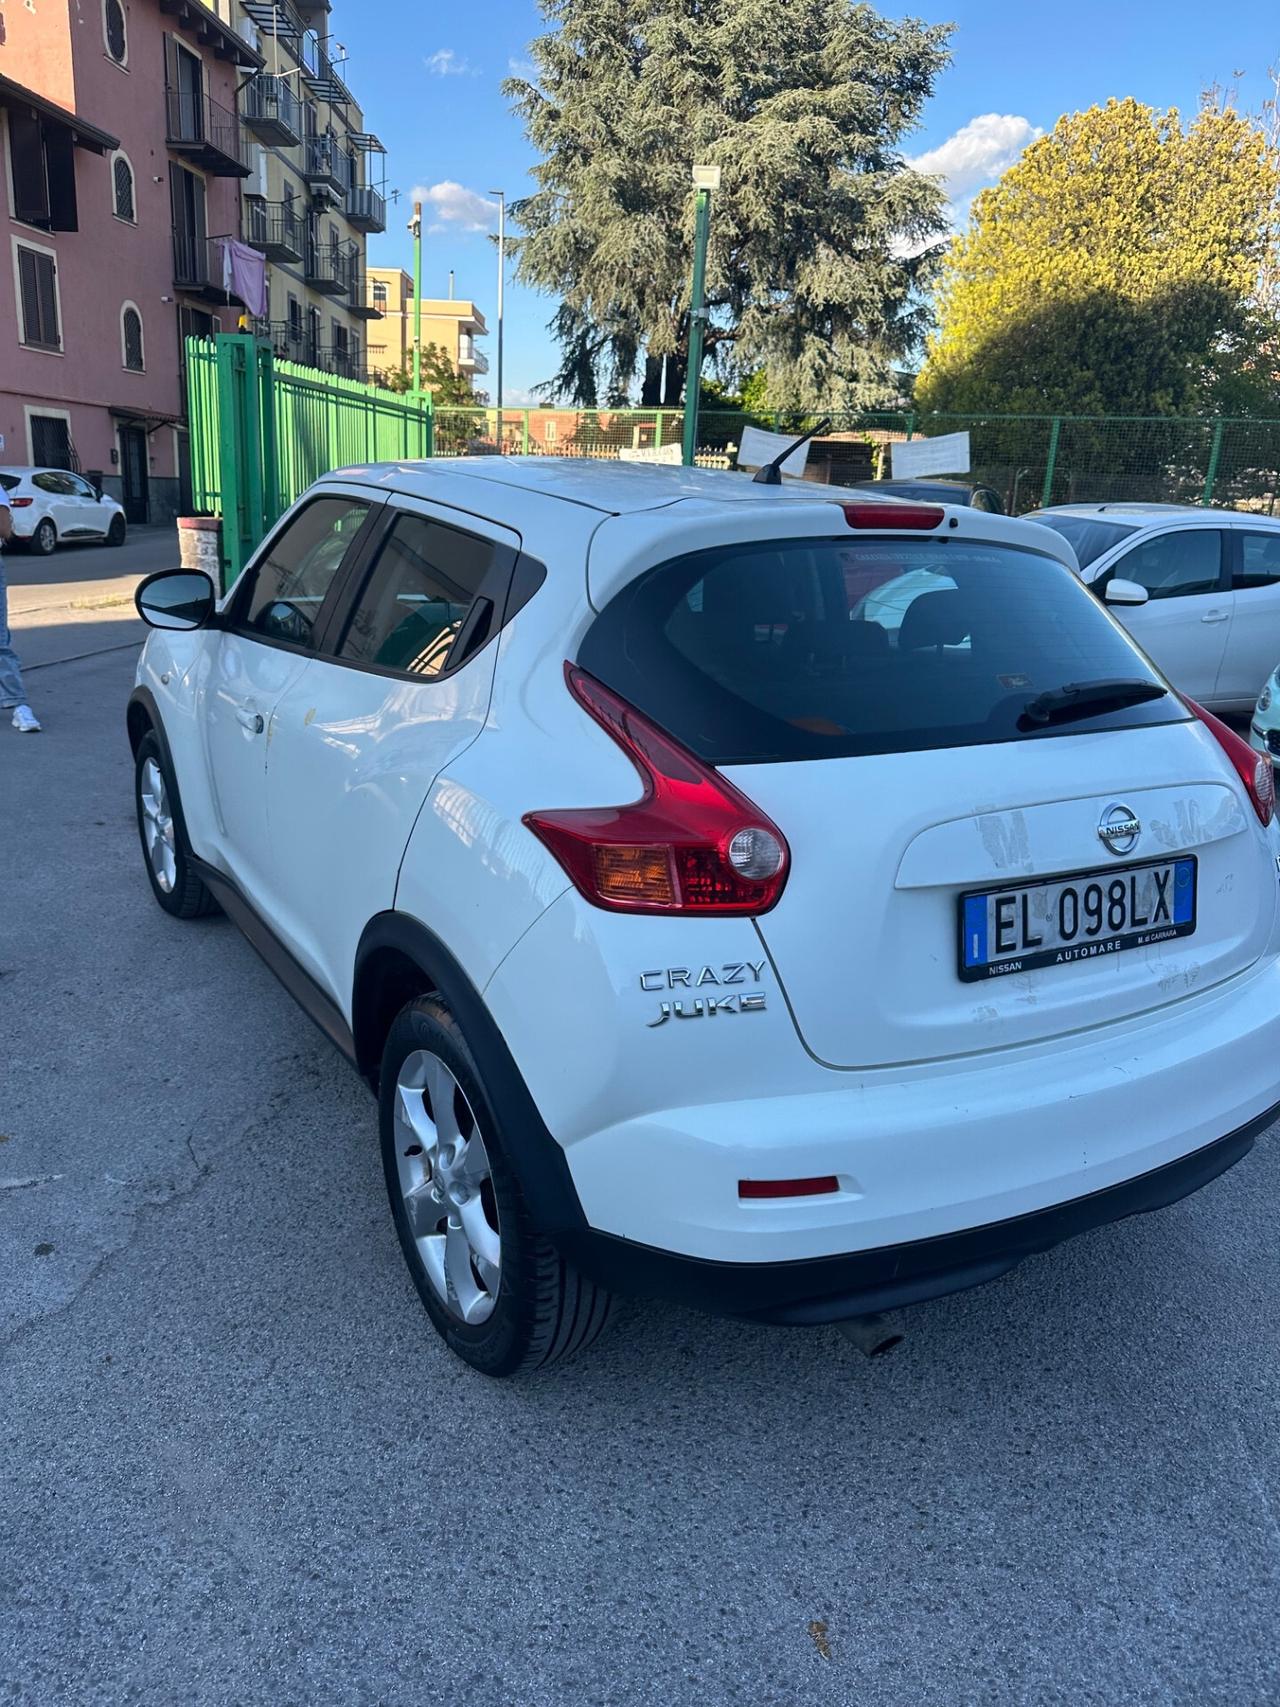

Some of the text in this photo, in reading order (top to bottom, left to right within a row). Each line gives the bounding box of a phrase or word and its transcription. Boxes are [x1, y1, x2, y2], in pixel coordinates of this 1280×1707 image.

[1106, 821, 1140, 835] NISSAN
[995, 869, 1170, 954] EL 098LX
[1056, 940, 1121, 962] AUTOMARE
[640, 961, 766, 991] CRAZY
[989, 961, 1022, 975] NISSAN
[646, 992, 767, 1028] JUKE
